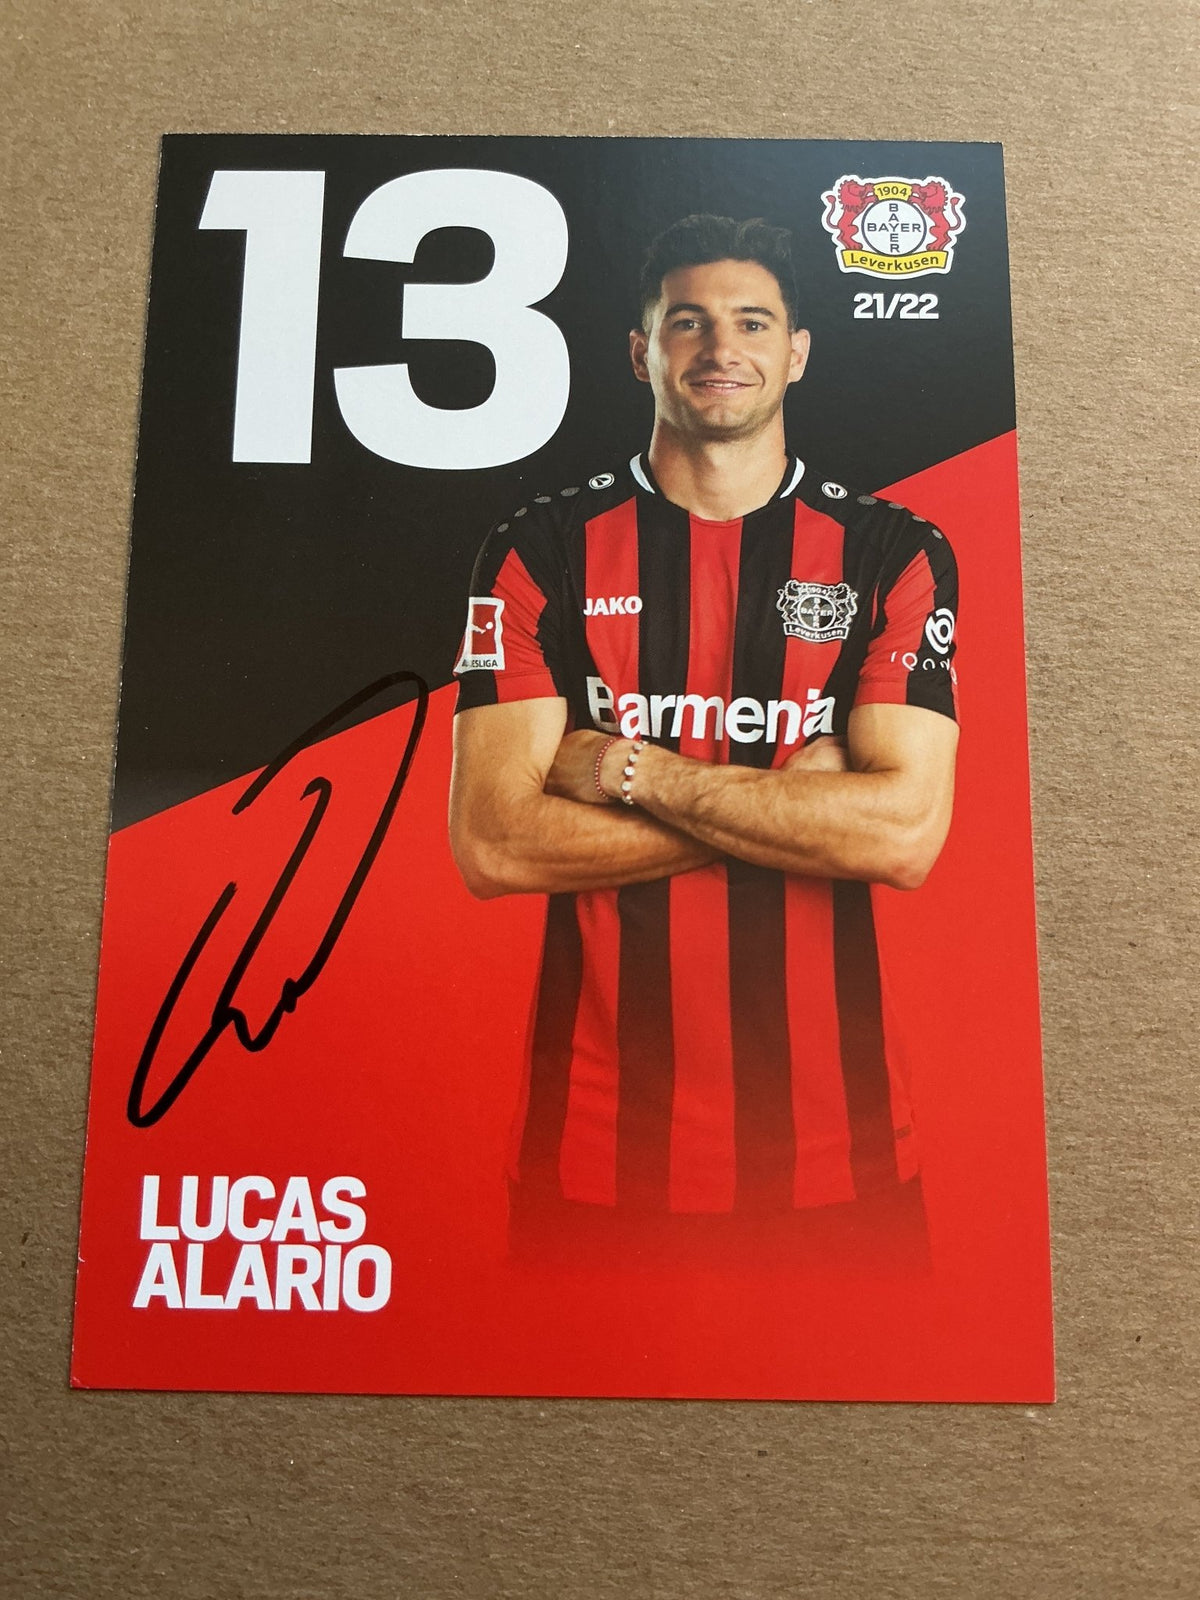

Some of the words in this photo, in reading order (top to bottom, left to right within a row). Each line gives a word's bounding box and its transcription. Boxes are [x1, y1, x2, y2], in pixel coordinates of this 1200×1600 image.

[877, 186, 908, 197] 1904
[867, 223, 922, 232] BAYER
[888, 203, 900, 253] BAYER
[850, 253, 940, 271] Leverkusen
[853, 292, 940, 319] 21/22
[199, 168, 571, 470] 13
[583, 596, 643, 616] JAKO
[789, 625, 843, 639] Leverkusen
[140, 1175, 367, 1243] LUCAS
[132, 1243, 392, 1312] ALARIO
